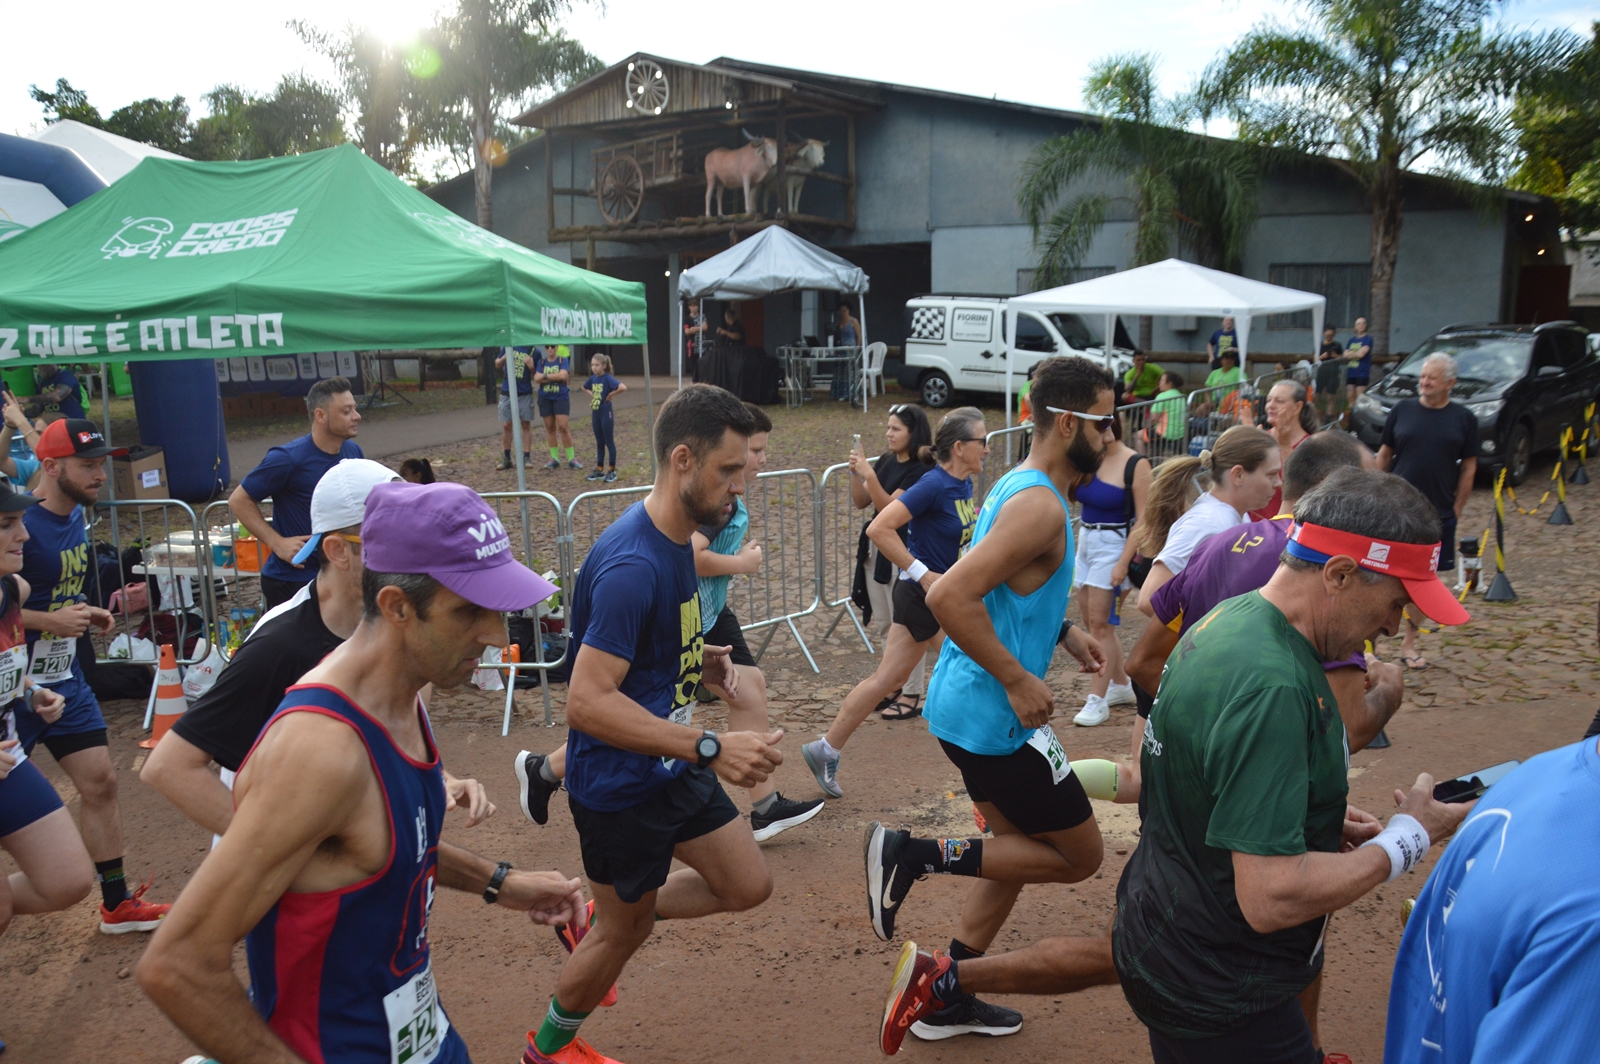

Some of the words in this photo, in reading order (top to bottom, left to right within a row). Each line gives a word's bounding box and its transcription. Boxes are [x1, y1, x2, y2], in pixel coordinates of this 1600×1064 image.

[181, 208, 298, 240] CROSS
[165, 229, 286, 257] CREDO
[957, 313, 988, 322] FIORINI
[28, 324, 98, 358] QUE
[106, 313, 130, 353] É
[139, 313, 284, 351] ATLETA
[43, 655, 70, 674] 1210
[898, 997, 923, 1027] FILA
